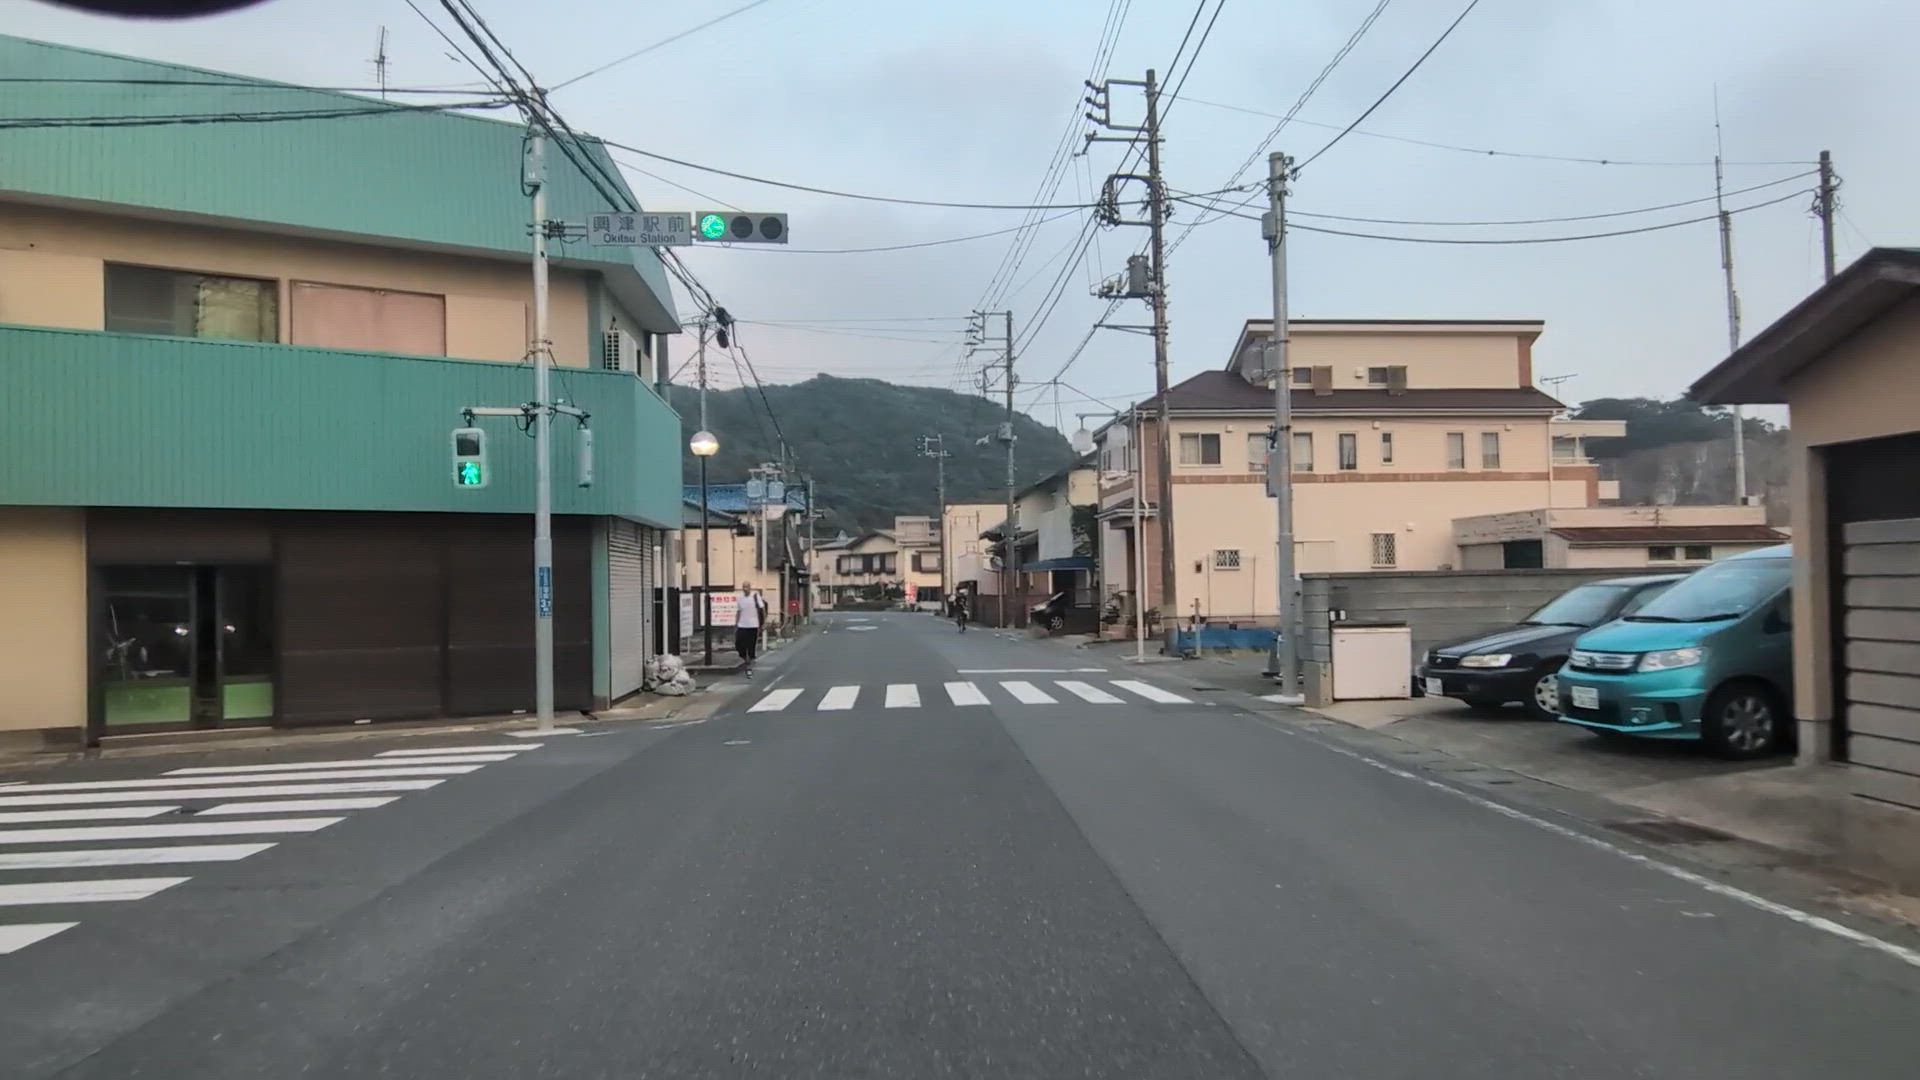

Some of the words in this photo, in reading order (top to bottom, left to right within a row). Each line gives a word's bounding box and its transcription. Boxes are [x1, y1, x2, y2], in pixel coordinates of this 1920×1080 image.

[593, 215, 684, 233] 興津駅前
[603, 233, 636, 243] Okitsu
[640, 233, 676, 243] Station
